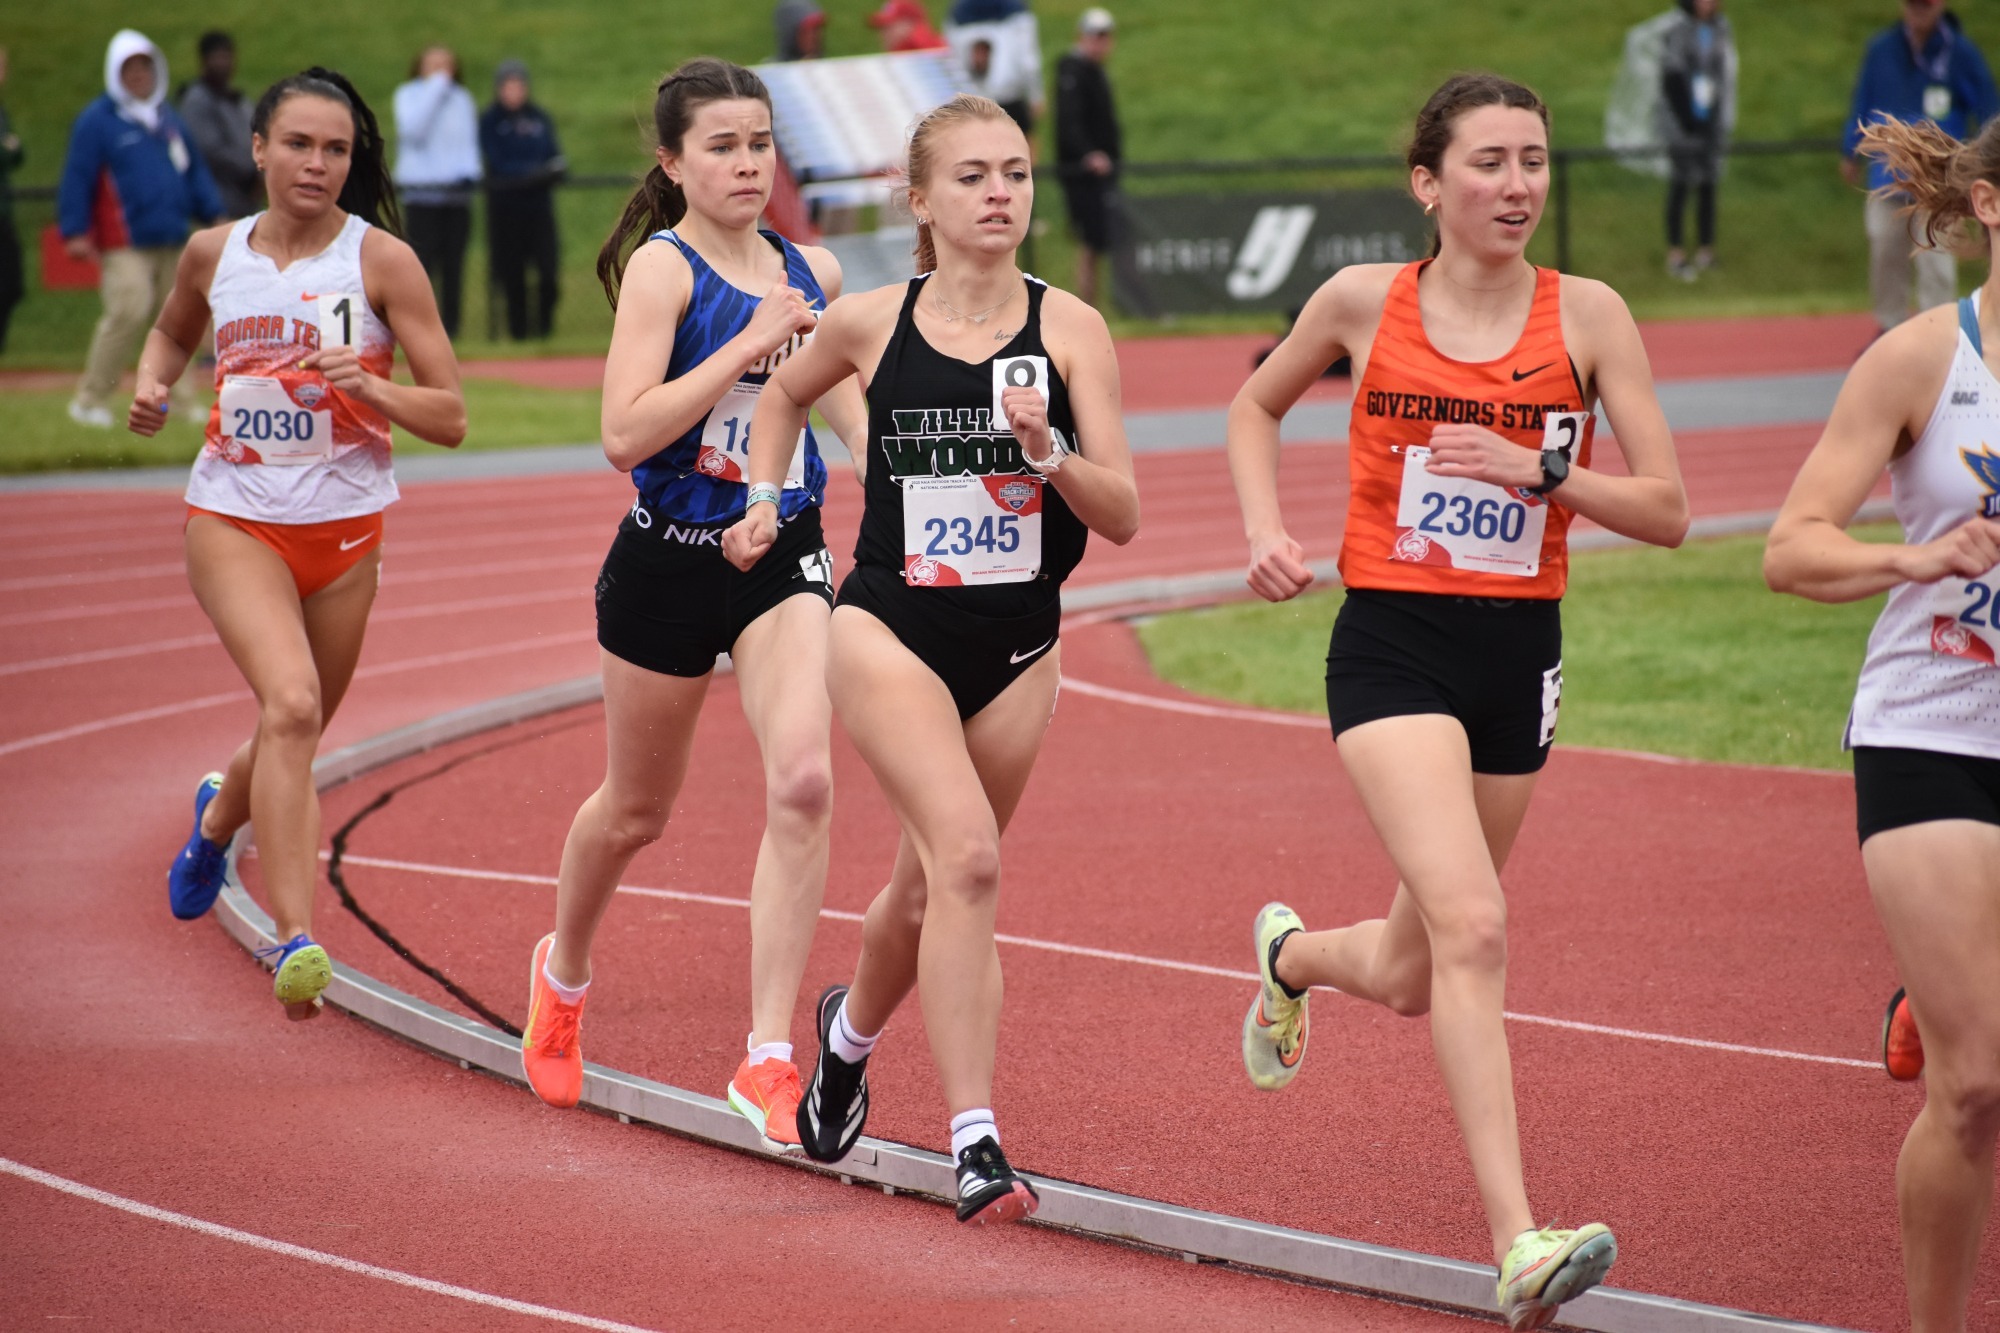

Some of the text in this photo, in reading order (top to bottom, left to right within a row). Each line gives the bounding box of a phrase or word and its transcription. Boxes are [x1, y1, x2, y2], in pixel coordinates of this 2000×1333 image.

[216, 315, 285, 352] NDIANA
[332, 298, 350, 345] 1
[234, 408, 314, 441] 2030
[892, 408, 995, 434] WILLI
[1367, 391, 1495, 426] GOVERNORS
[663, 524, 723, 546] NIK
[924, 514, 1020, 557] 2345
[1418, 492, 1526, 543] 2360
